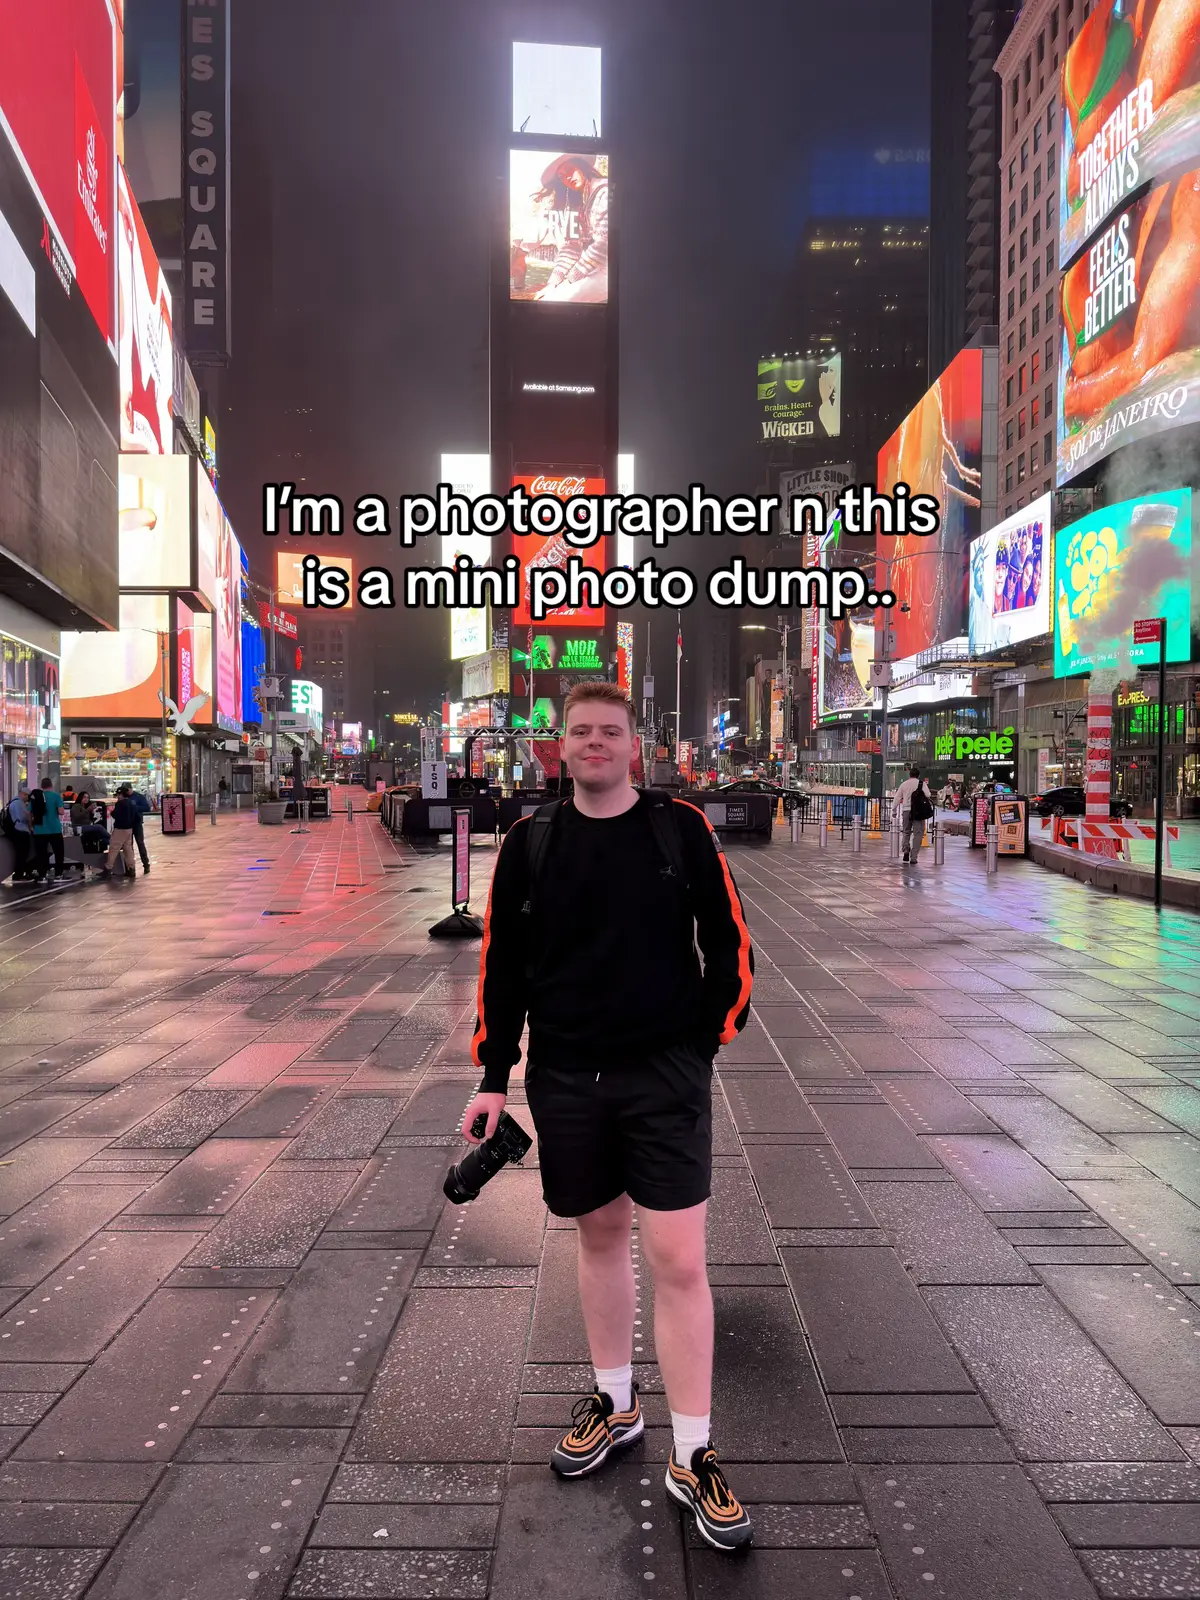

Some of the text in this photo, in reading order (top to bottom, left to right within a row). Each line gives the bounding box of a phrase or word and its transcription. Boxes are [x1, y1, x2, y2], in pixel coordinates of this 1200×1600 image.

[1078, 78, 1155, 198] TOGETHER
[77, 160, 107, 254] Emirates
[1084, 138, 1139, 236] ALWAYS
[189, 111, 217, 325] SQUARE
[1089, 213, 1129, 293] FEELS
[1084, 257, 1136, 343] BETTER
[522, 383, 548, 391] Available
[555, 384, 595, 394] Samsung.com
[764, 401, 814, 412] Brains. Heart.
[772, 410, 805, 419] Courage.
[1065, 386, 1187, 472] SOL DE JANEIRO
[530, 475, 586, 496] Coca-Cola
[787, 469, 850, 493] LITTLE SHOP
[1071, 526, 1118, 592] SOL
[565, 639, 598, 656] MOR
[680, 741, 690, 762] tkts
[955, 725, 1015, 760] pelé
